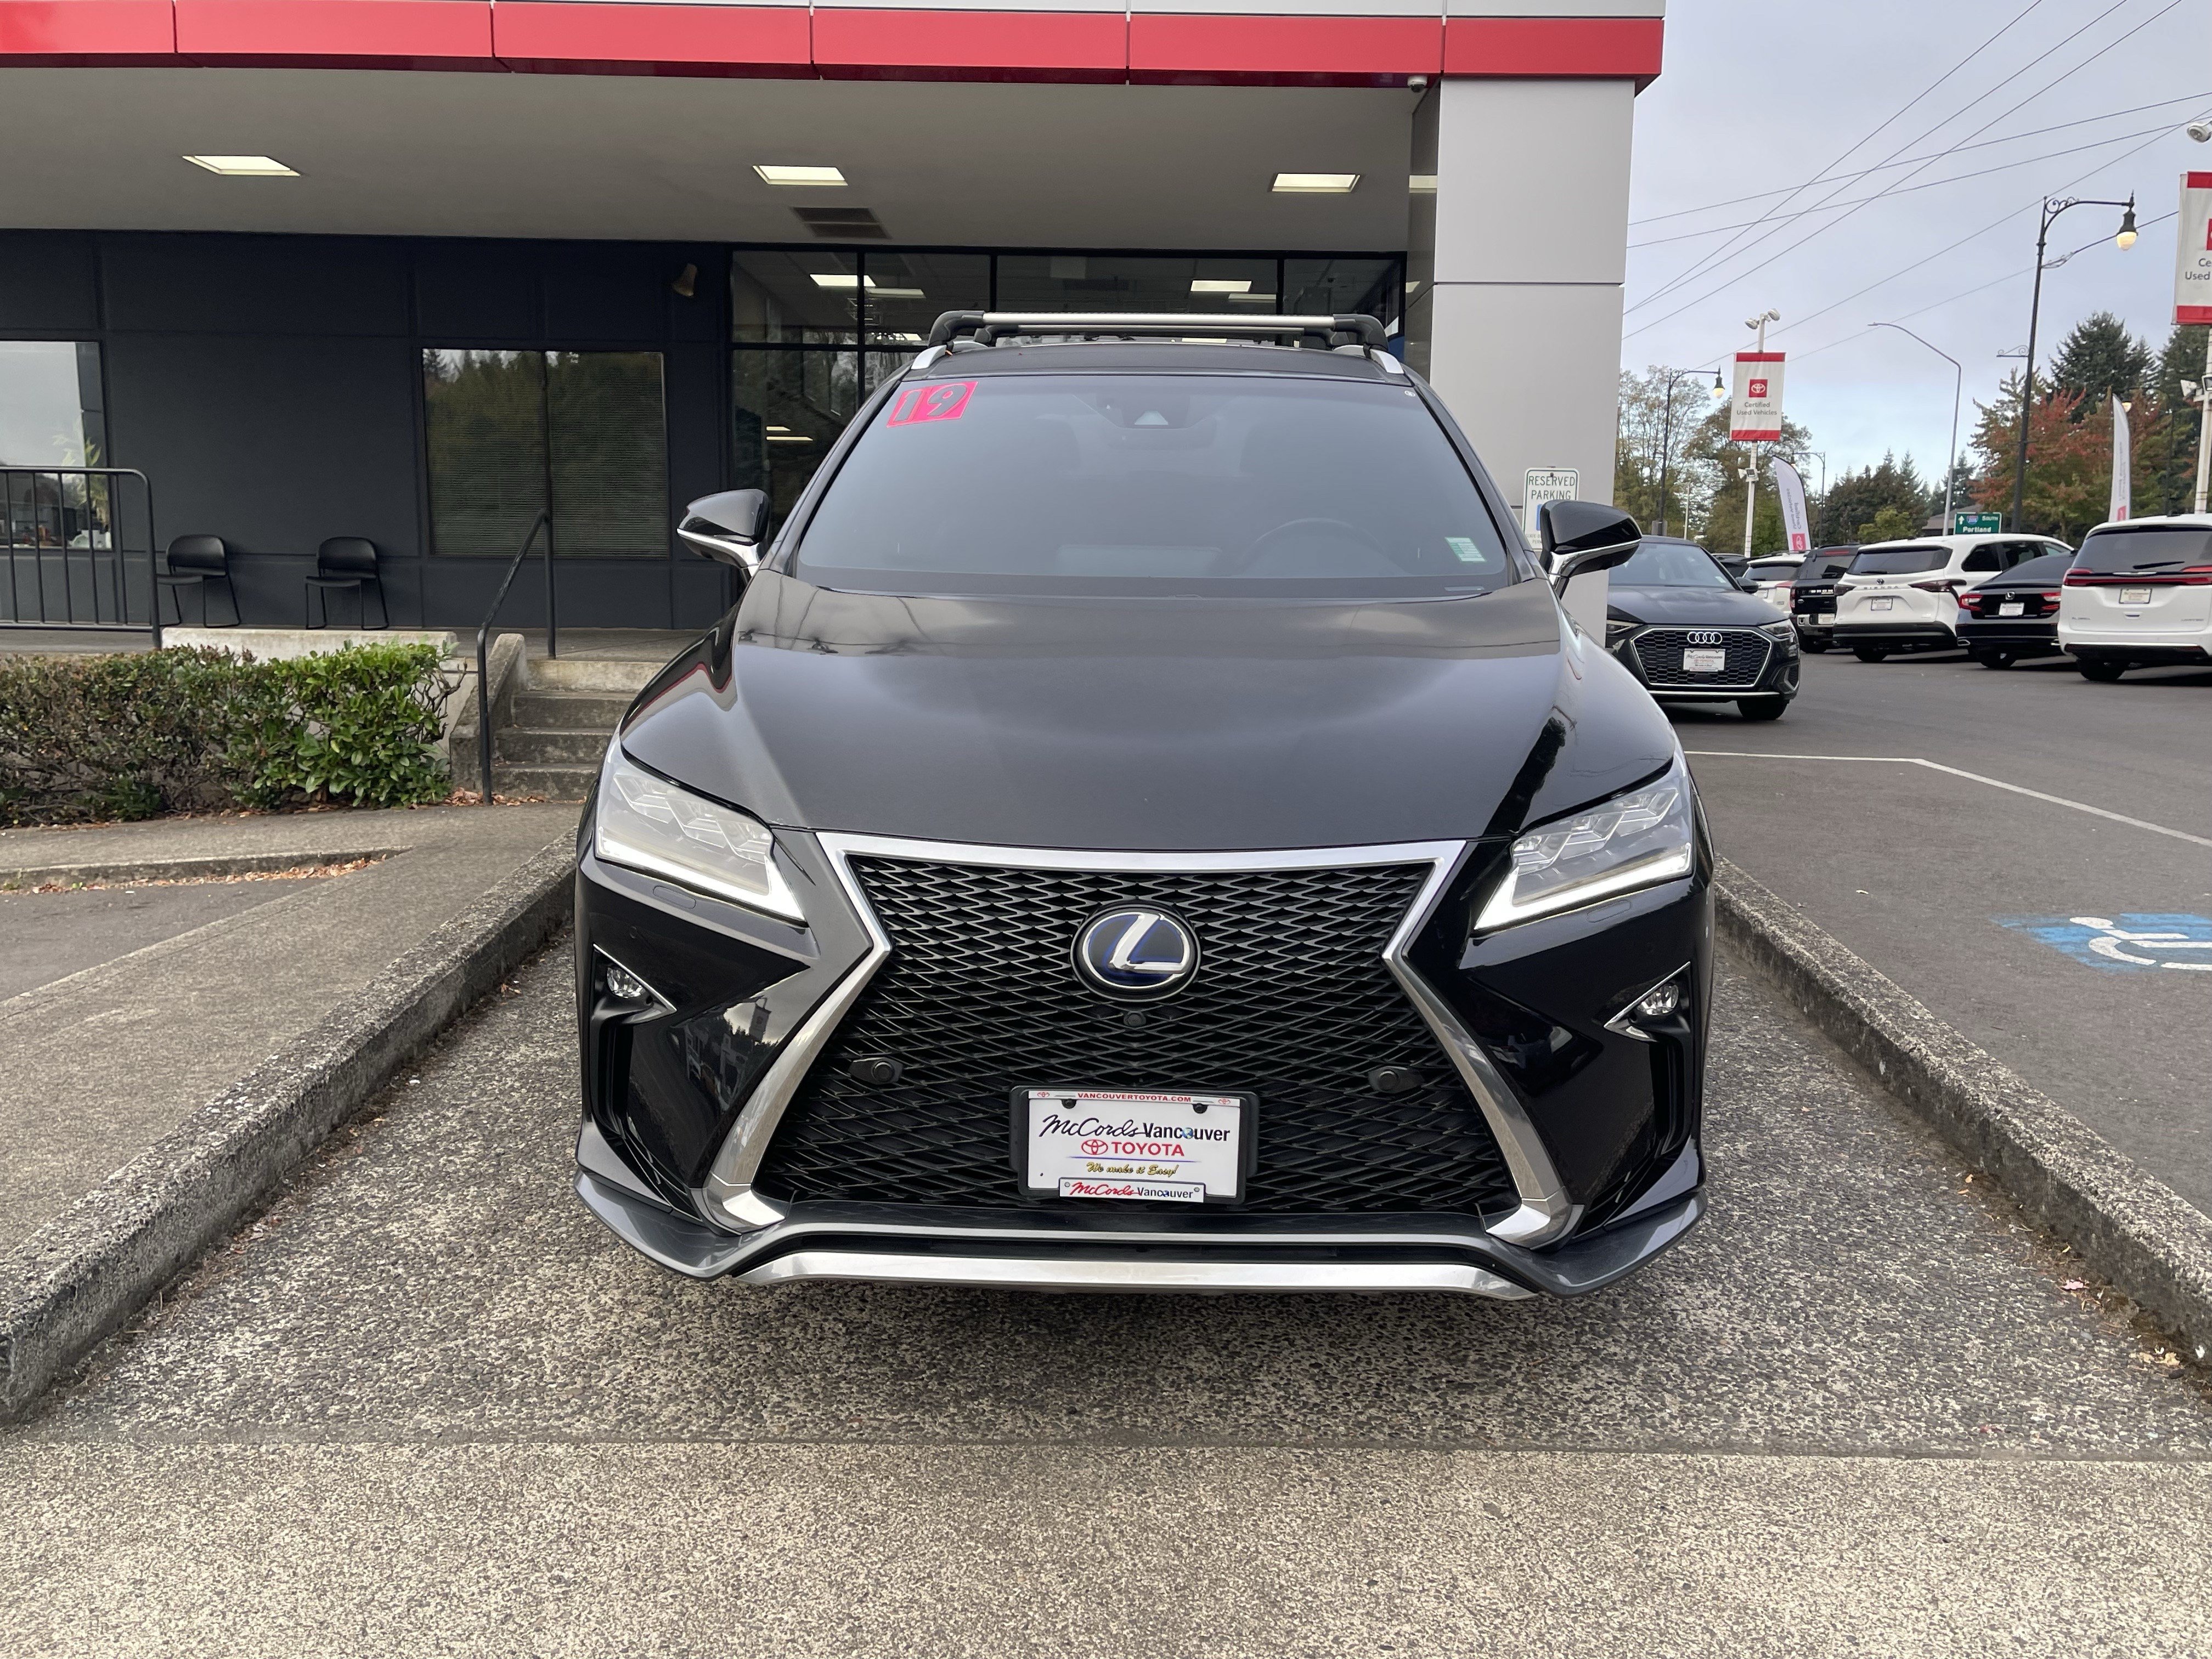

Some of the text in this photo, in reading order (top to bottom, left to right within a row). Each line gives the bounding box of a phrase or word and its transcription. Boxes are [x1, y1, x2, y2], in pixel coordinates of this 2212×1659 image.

[2185, 271, 2211, 280] Used
[893, 385, 968, 422] 19
[1528, 476, 1576, 486] RESERVED
[1531, 490, 1571, 500] PARKING
[1078, 1092, 1192, 1103] VANCOUVERTOYOTA.COM
[1111, 1141, 1185, 1156] TOYOTA
[1086, 1162, 1104, 1172] We
[1106, 1164, 1134, 1173] make
[1147, 1164, 1179, 1177] Easy!
